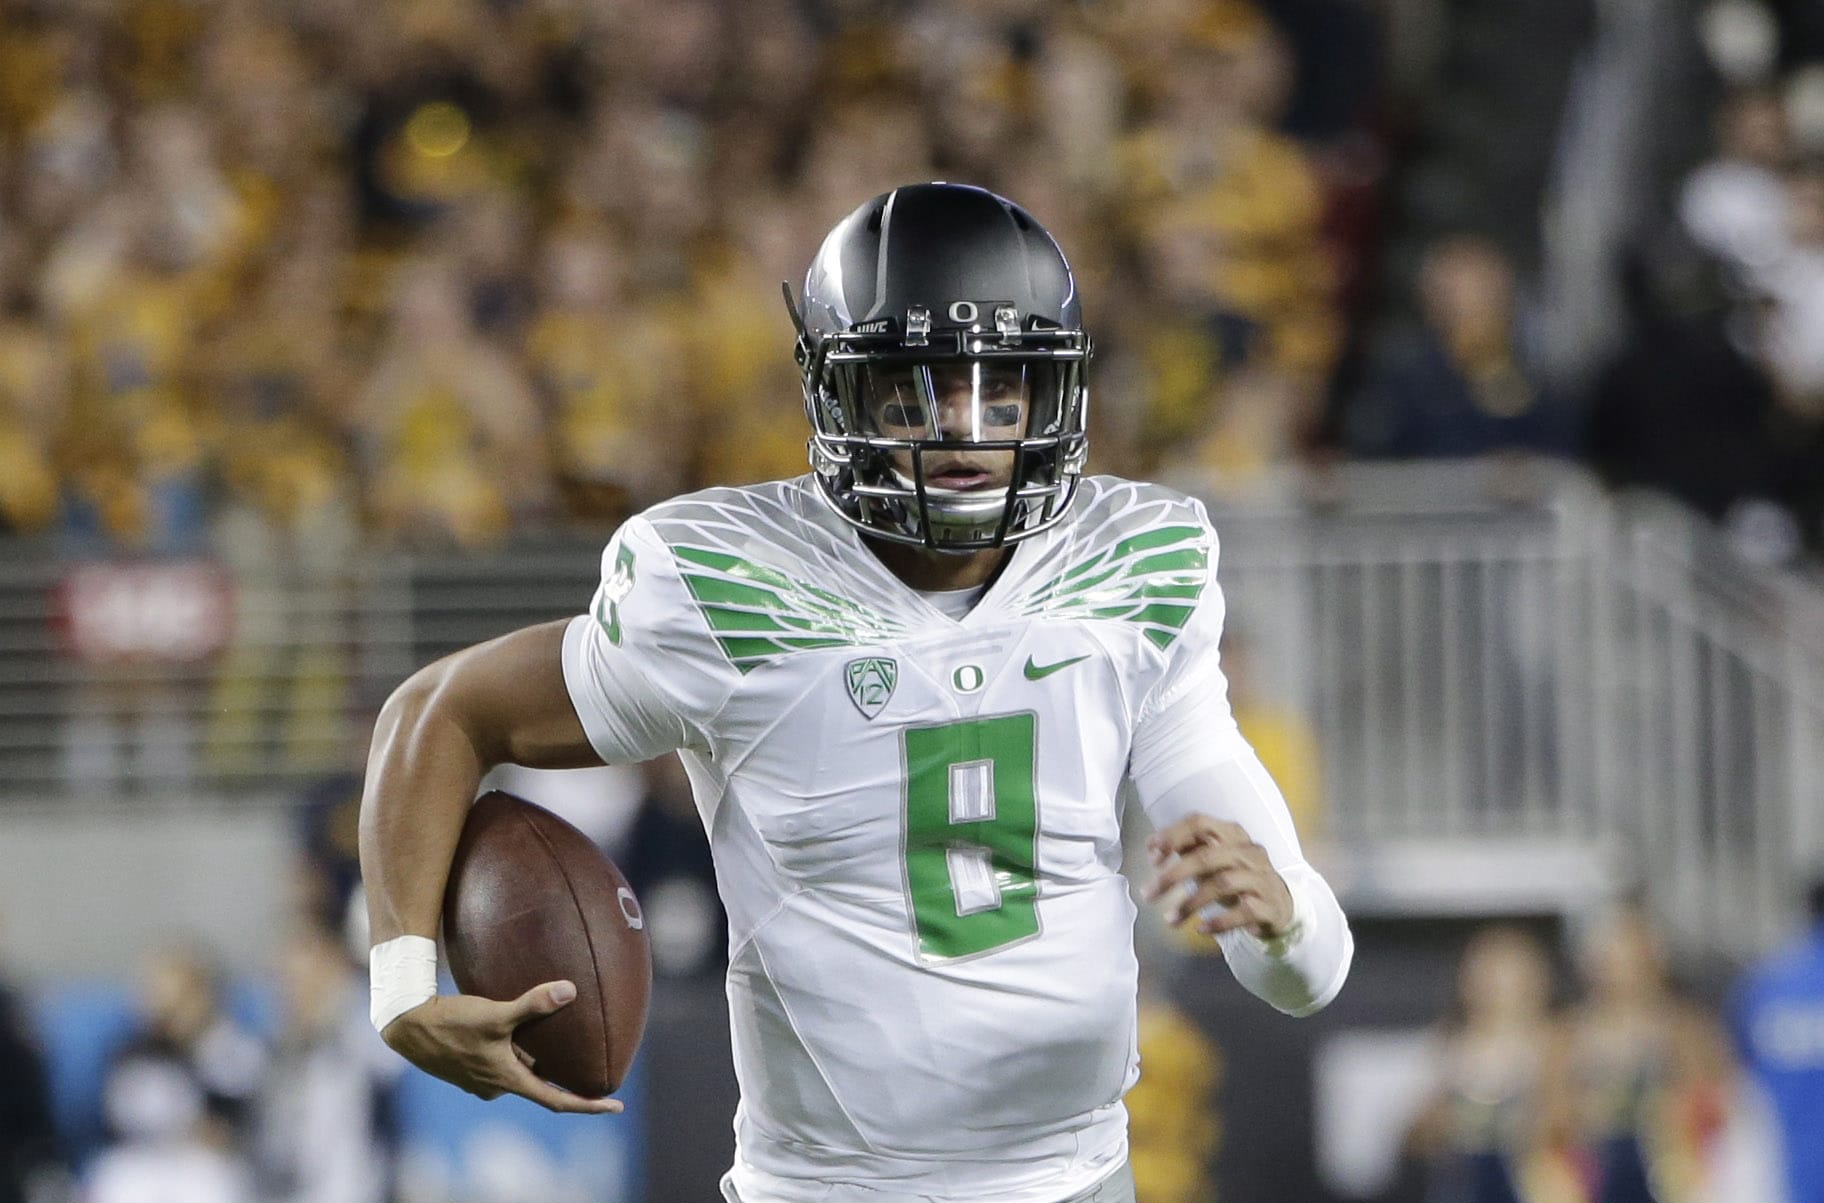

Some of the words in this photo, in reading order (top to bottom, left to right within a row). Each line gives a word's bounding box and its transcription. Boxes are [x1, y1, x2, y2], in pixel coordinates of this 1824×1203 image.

[948, 301, 979, 323] O
[847, 658, 895, 695] PAC
[952, 664, 985, 693] O
[859, 684, 884, 706] 12
[898, 709, 1043, 966] 8
